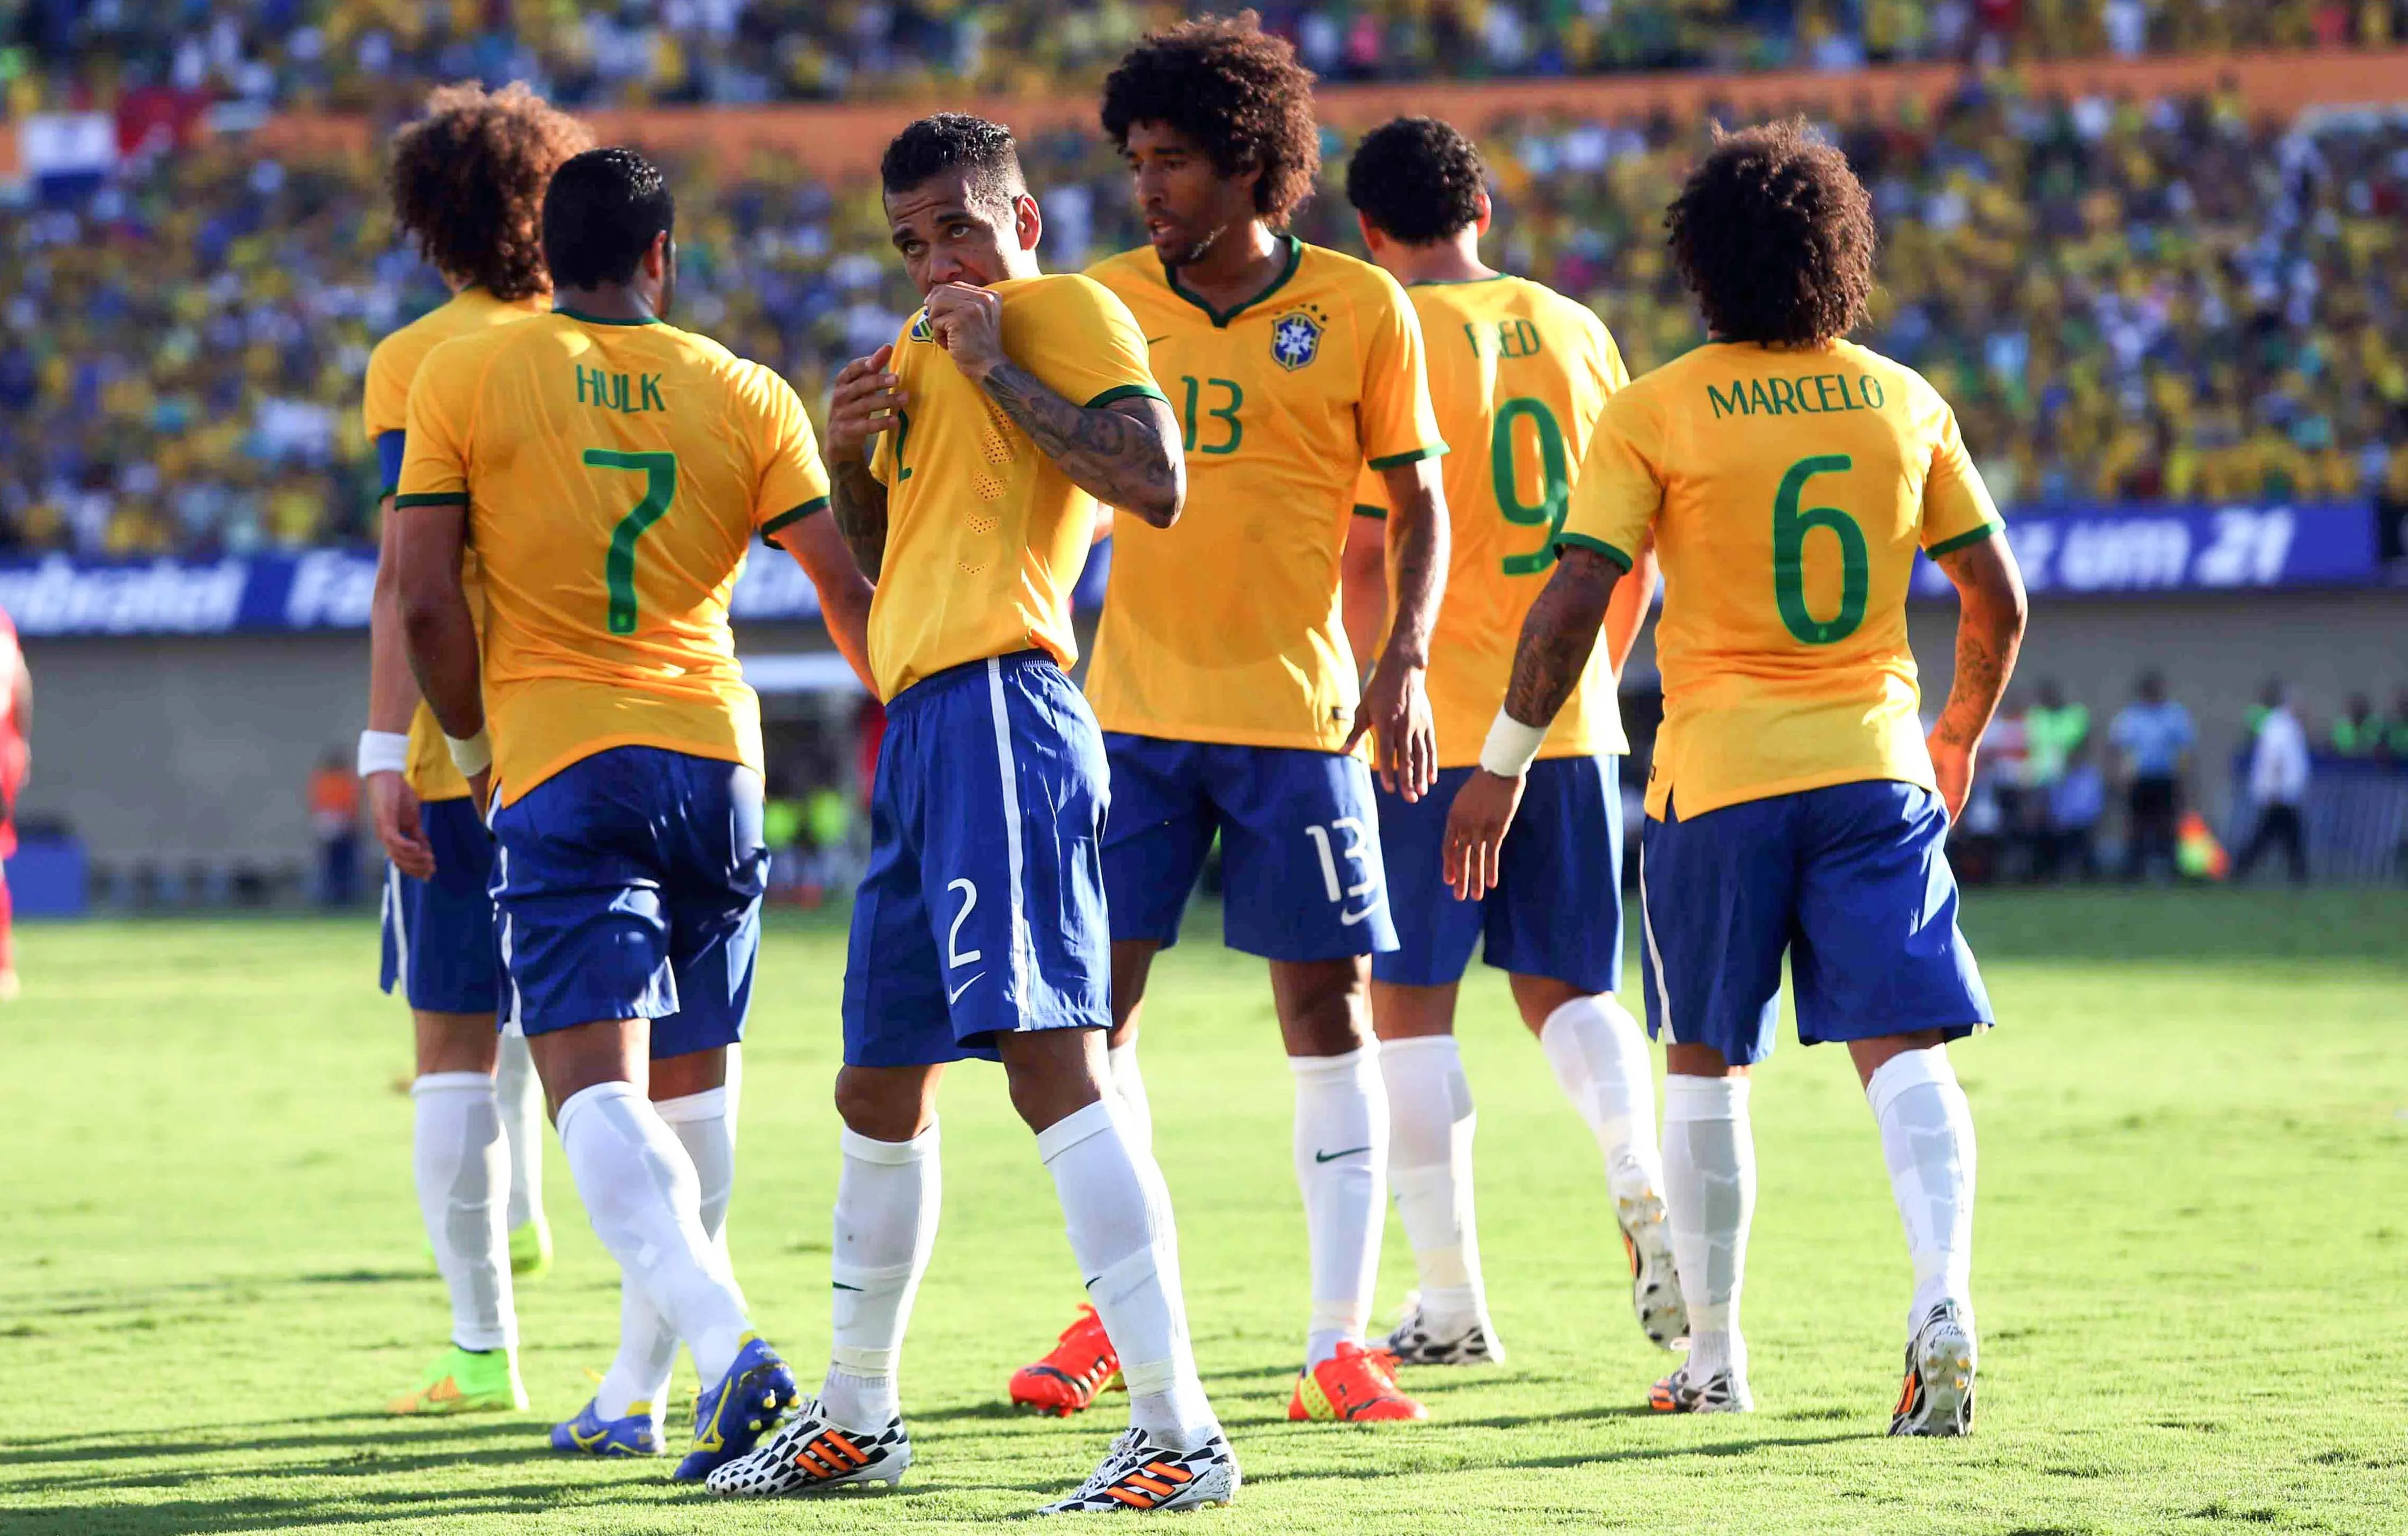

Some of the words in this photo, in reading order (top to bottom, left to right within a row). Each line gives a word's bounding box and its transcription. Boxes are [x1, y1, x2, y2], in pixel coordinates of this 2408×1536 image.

[1463, 318, 1541, 359] FED
[576, 364, 665, 413] HULK
[1181, 376, 1244, 454] 13
[1707, 374, 1885, 419] MARCELO
[1492, 397, 1569, 576] 9
[582, 448, 677, 635] 7
[1773, 454, 1869, 645] 6
[2196, 506, 2295, 586] 21
[1305, 816, 1377, 902] 13
[948, 878, 981, 969] 2
